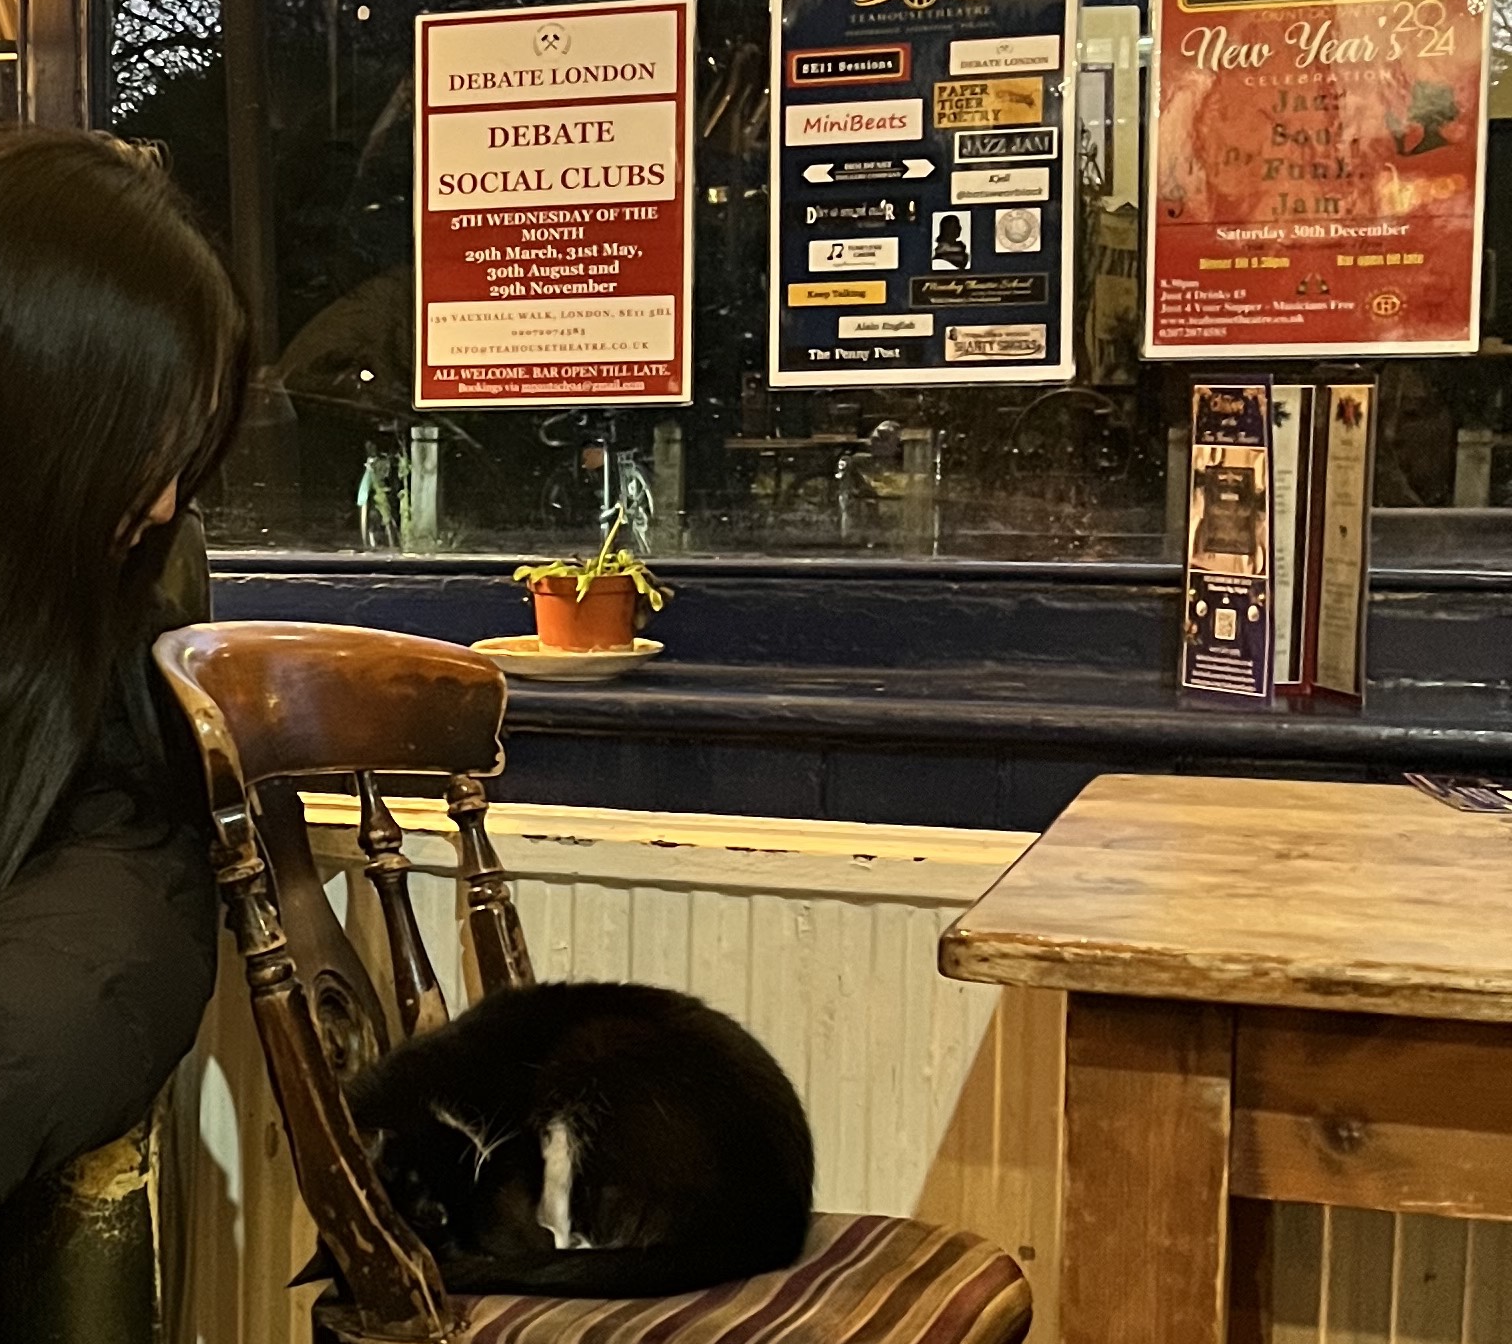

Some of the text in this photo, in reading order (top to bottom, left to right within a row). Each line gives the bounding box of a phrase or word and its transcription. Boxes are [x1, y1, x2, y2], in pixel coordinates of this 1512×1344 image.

[1181, 15, 1403, 72] New Year's
[448, 62, 656, 91] DEBATE LONDON
[802, 59, 893, 74] SE11 Sessions
[1244, 68, 1395, 86] CELEBRATION
[937, 84, 990, 98] PAPER
[937, 98, 984, 111] TIGER
[803, 113, 908, 134] MiniBeats
[937, 109, 1002, 124] POETRY
[488, 120, 615, 148] DEBATE
[962, 135, 1050, 155] JAZZ JAM
[438, 162, 666, 196] SOCIAL CLUBS
[450, 206, 658, 230] 5TH WEDNESDAY OF THE
[521, 226, 585, 242] MONTH
[1216, 222, 1410, 243] Saturday 30th December
[465, 247, 502, 264] 29th
[566, 243, 598, 261] 31st
[603, 242, 643, 258] May,
[486, 260, 620, 282] 30th August and
[489, 279, 618, 299] 29th November
[452, 311, 514, 323] VAUXHALL
[808, 349, 830, 361] The
[434, 367, 458, 381] ALL
[533, 365, 559, 379] BAR
[561, 364, 598, 378] OPEN
[600, 364, 631, 377] TILL
